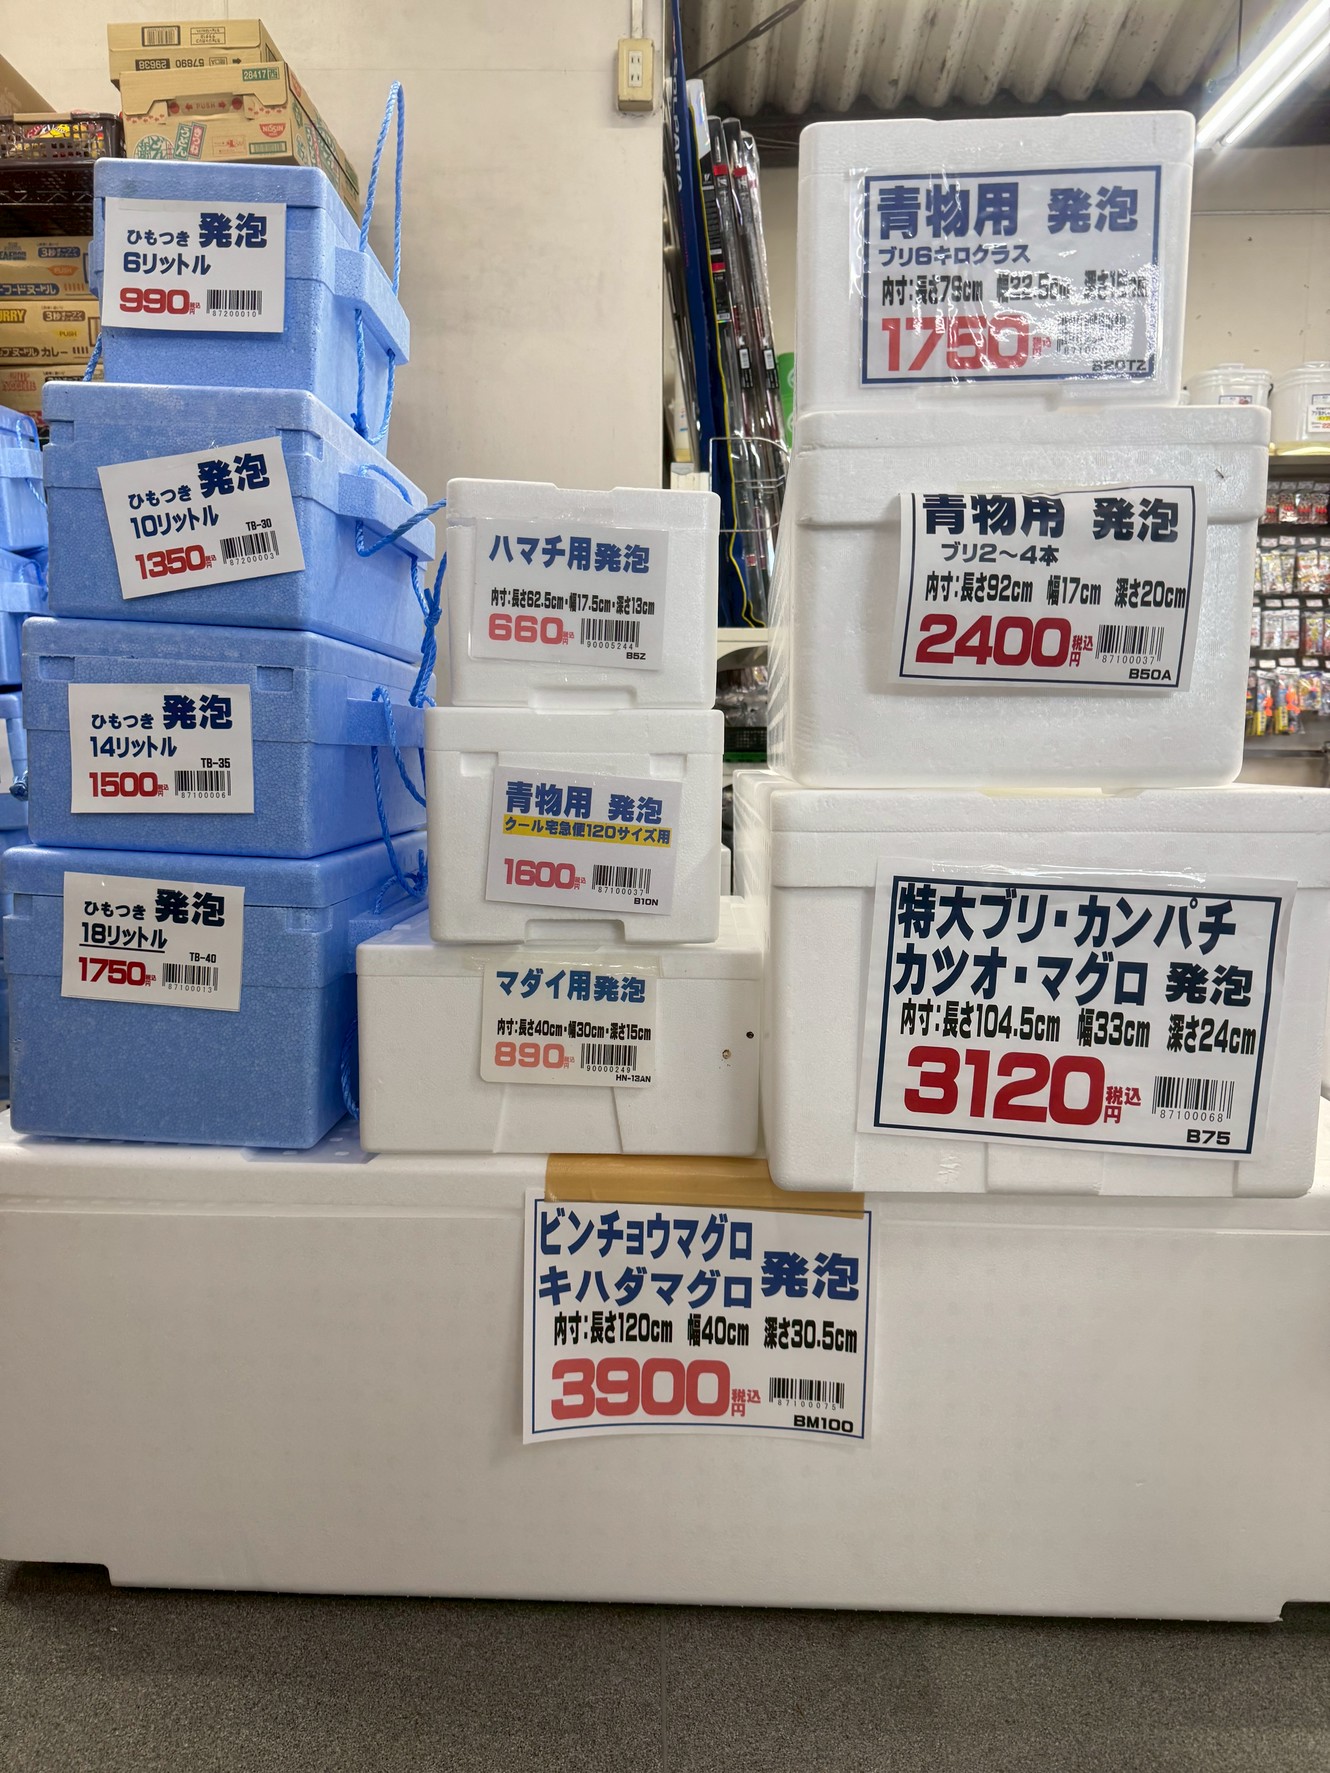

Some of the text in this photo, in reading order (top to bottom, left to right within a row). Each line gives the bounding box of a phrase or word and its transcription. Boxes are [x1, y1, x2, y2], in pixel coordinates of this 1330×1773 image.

[138, 60, 167, 70] 29638
[175, 58, 204, 68] 57890
[244, 70, 266, 80] 28417
[262, 124, 284, 133] NISSIN
[877, 182, 1138, 240] 青物用 発泡
[127, 212, 268, 248] ひもつき 発泡
[124, 252, 212, 276] 6リットル
[878, 244, 1031, 267] ブリ6キロクラス
[120, 288, 190, 314] 990
[41, 346, 68, 357] カレー
[881, 314, 1030, 372] 1750
[128, 453, 270, 510] ひもつき 発泡
[130, 505, 219, 539] 10リットル
[245, 518, 272, 531] TB-30
[922, 494, 1179, 542] 青物用 発泡
[135, 544, 206, 580] 1350
[229, 553, 274, 566] 87200003
[488, 535, 650, 574] ハマチ用発泡
[1047, 575, 1102, 606] 幅17cm
[1114, 578, 1187, 609] 深さ20cm
[488, 613, 564, 645] 660
[915, 613, 1072, 668] 2400
[587, 641, 633, 650] 90005244
[1072, 635, 1093, 652] 税込
[626, 652, 646, 660] B5Z
[1069, 652, 1081, 667] 円
[1102, 655, 1155, 664] 87100037
[1128, 668, 1172, 681] B50A
[91, 695, 233, 730] ひもつき 発泡
[90, 736, 178, 758] 14リットル
[201, 758, 230, 768] TB-35
[89, 772, 158, 797] 1500
[506, 781, 662, 824] 青物用 発泡
[505, 816, 670, 844] クール宅急便120サイズ用
[504, 858, 575, 890] 1600
[598, 887, 644, 896] 87100037
[634, 897, 658, 906] B10N
[84, 888, 225, 927] ひもつき 発泡
[898, 883, 1237, 956] 特大ブリ・カンパチ
[82, 922, 168, 949] 18リットル
[189, 952, 216, 963] TB-40
[78, 957, 146, 986] 1750
[892, 943, 1253, 1007] カツオ・マグロ 発泡
[168, 983, 212, 993] 87100013
[496, 968, 646, 1003] マダイ用発泡
[1077, 1008, 1151, 1048] 幅33cm
[1167, 1014, 1256, 1055] 深さ24cm
[495, 1041, 564, 1069] 890
[587, 1065, 631, 1073] 90000249
[616, 1074, 651, 1082] HN-13AN
[904, 1046, 1106, 1126] 3120
[1106, 1086, 1142, 1106] 税込
[1104, 1106, 1121, 1124] 円
[1160, 1108, 1223, 1123] 87100068
[1186, 1129, 1231, 1145] B75
[540, 1207, 859, 1301] ビンチョウマグロ 発泡
[538, 1266, 752, 1309] キハダマグロ
[688, 1314, 749, 1347] 幅40cm
[764, 1316, 857, 1354] 深さ30.5cm
[551, 1357, 730, 1420] 3900
[731, 1388, 761, 1404] 税込
[731, 1403, 746, 1417] 円
[776, 1399, 837, 1411] 87100075
[793, 1415, 853, 1432] BM100
